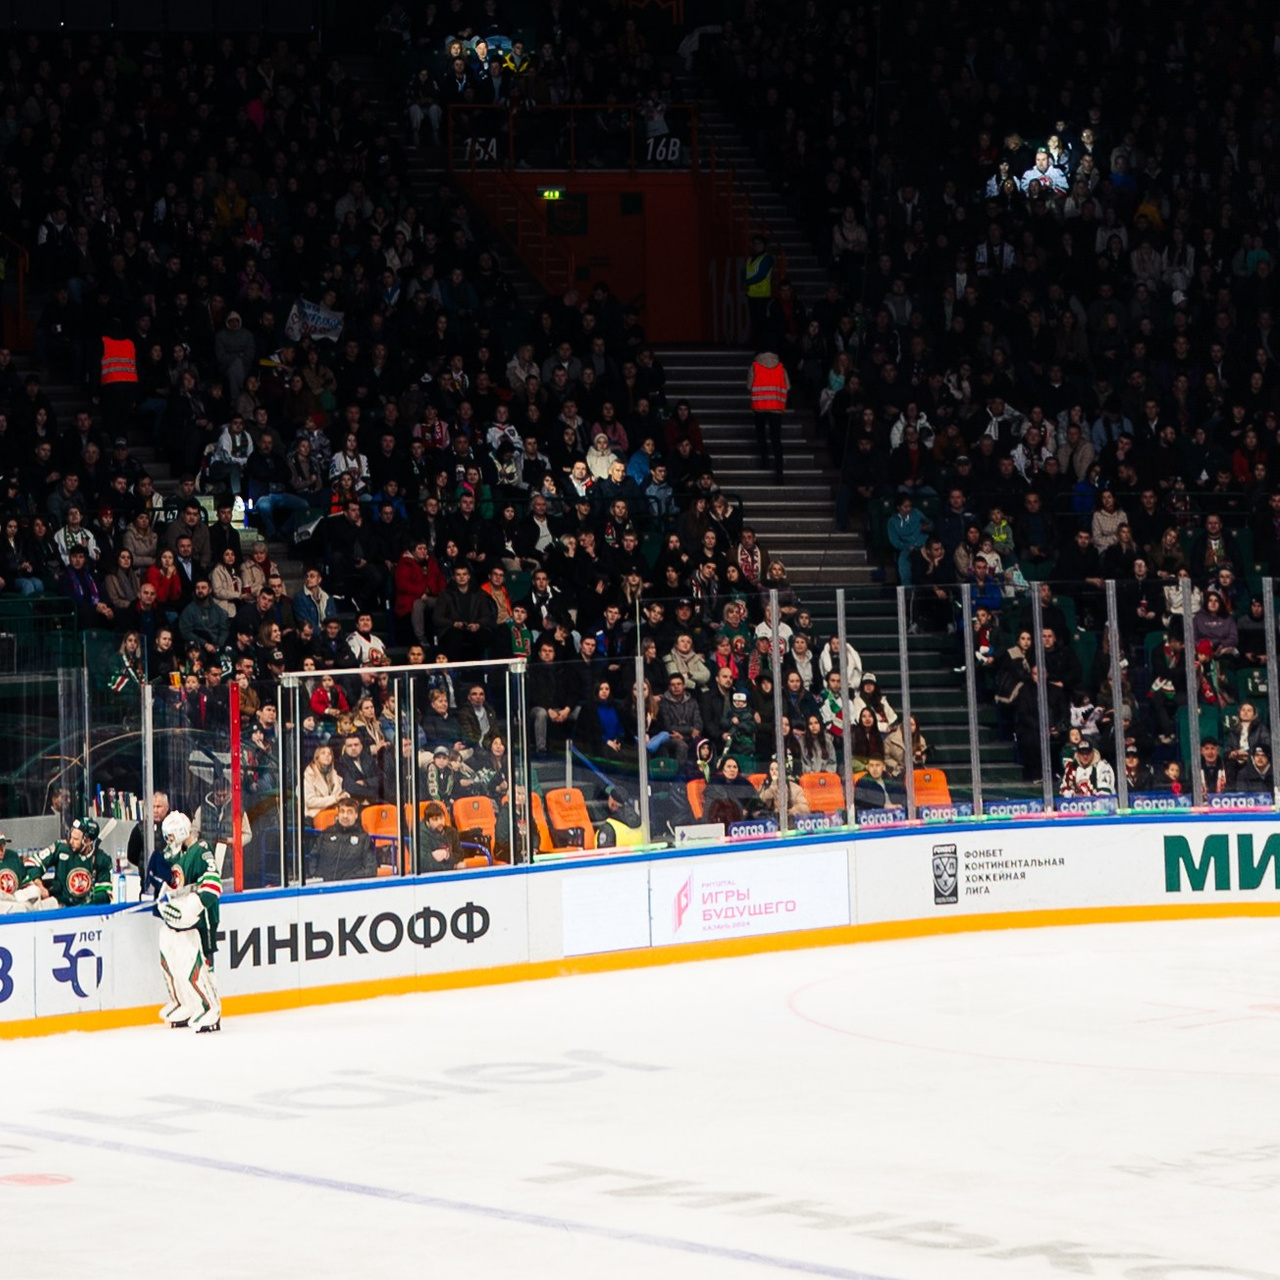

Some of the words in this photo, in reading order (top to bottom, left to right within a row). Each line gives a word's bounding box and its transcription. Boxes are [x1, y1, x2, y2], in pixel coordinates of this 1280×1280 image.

[645, 134, 681, 162] 16B
[1133, 798, 1175, 810] согаз
[1210, 795, 1255, 808] согаз
[921, 807, 958, 821] согаз
[989, 804, 1028, 816] согаз
[797, 817, 830, 831] согаз
[860, 811, 893, 825] согаз
[730, 824, 765, 838] согаз
[963, 848, 1004, 859] ФОНБЕТ
[964, 858, 1065, 871] КОНТИНЕНТАЛЬНАЯ
[1163, 833, 1280, 893] МИ
[965, 871, 1026, 883] ХОККЕЙНАЯ
[702, 888, 751, 906] ИГРЫ
[965, 886, 990, 896] ЛИГА
[702, 900, 797, 922] БУДУЩЕГО
[79, 929, 103, 943] лет
